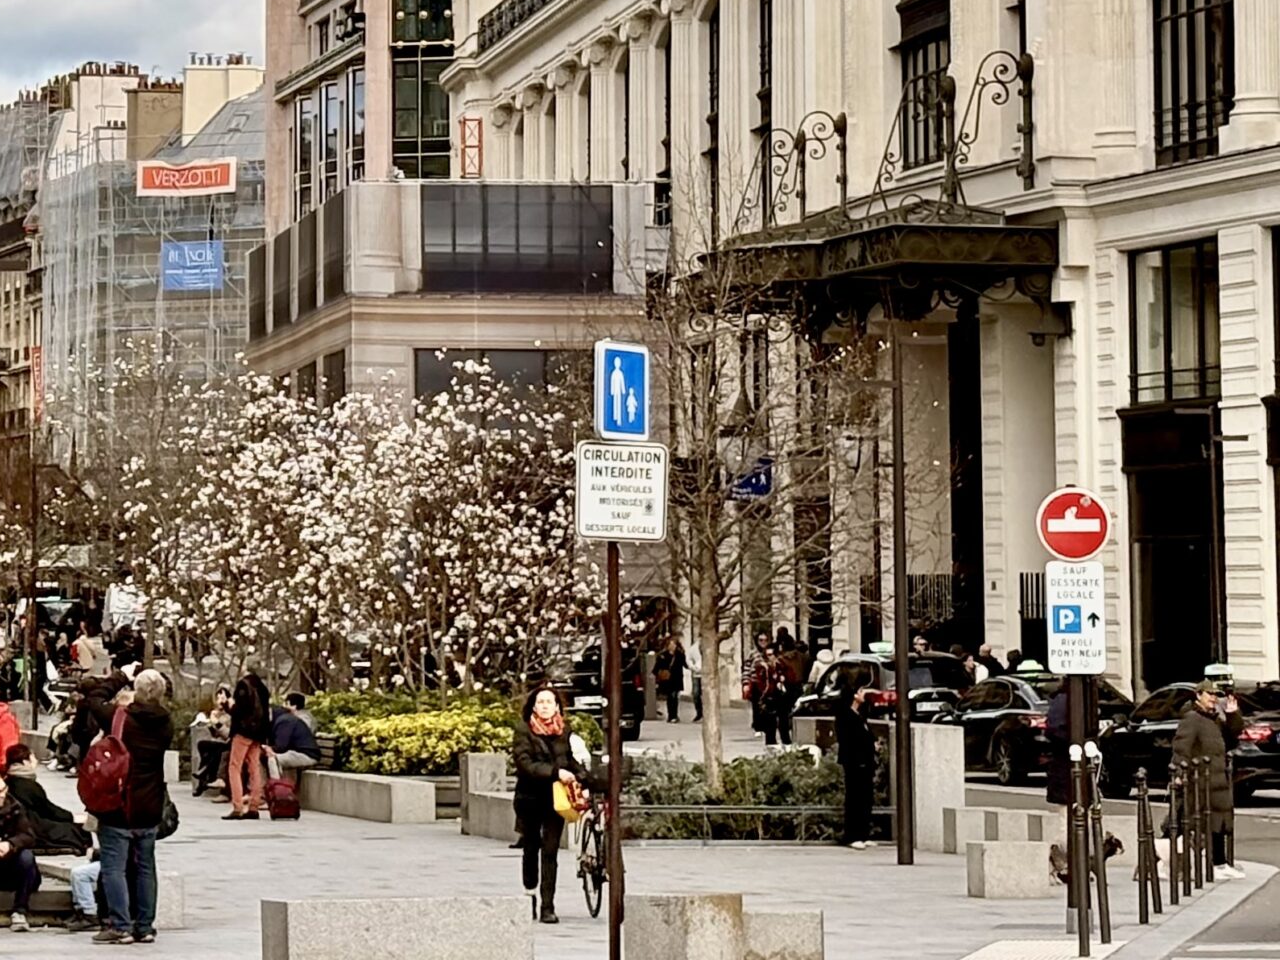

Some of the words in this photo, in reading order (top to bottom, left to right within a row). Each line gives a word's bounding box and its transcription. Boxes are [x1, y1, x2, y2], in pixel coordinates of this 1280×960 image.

[152, 167, 221, 187] VERZOTTI
[583, 448, 662, 464] CIRCULATION
[591, 466, 653, 480] INTERDITE
[591, 483, 606, 492] AUX
[610, 484, 653, 494] VÉHICULES
[611, 511, 632, 520] SAUF
[585, 523, 624, 533] DESSERTE
[627, 525, 657, 535] LOCALE
[1062, 566, 1088, 575] SAUF
[1050, 578, 1100, 588] DESSERTE
[1056, 591, 1095, 600] LOCALE
[1059, 608, 1075, 631] P
[1061, 638, 1093, 647] RIVOLI
[1061, 661, 1072, 669] ET
